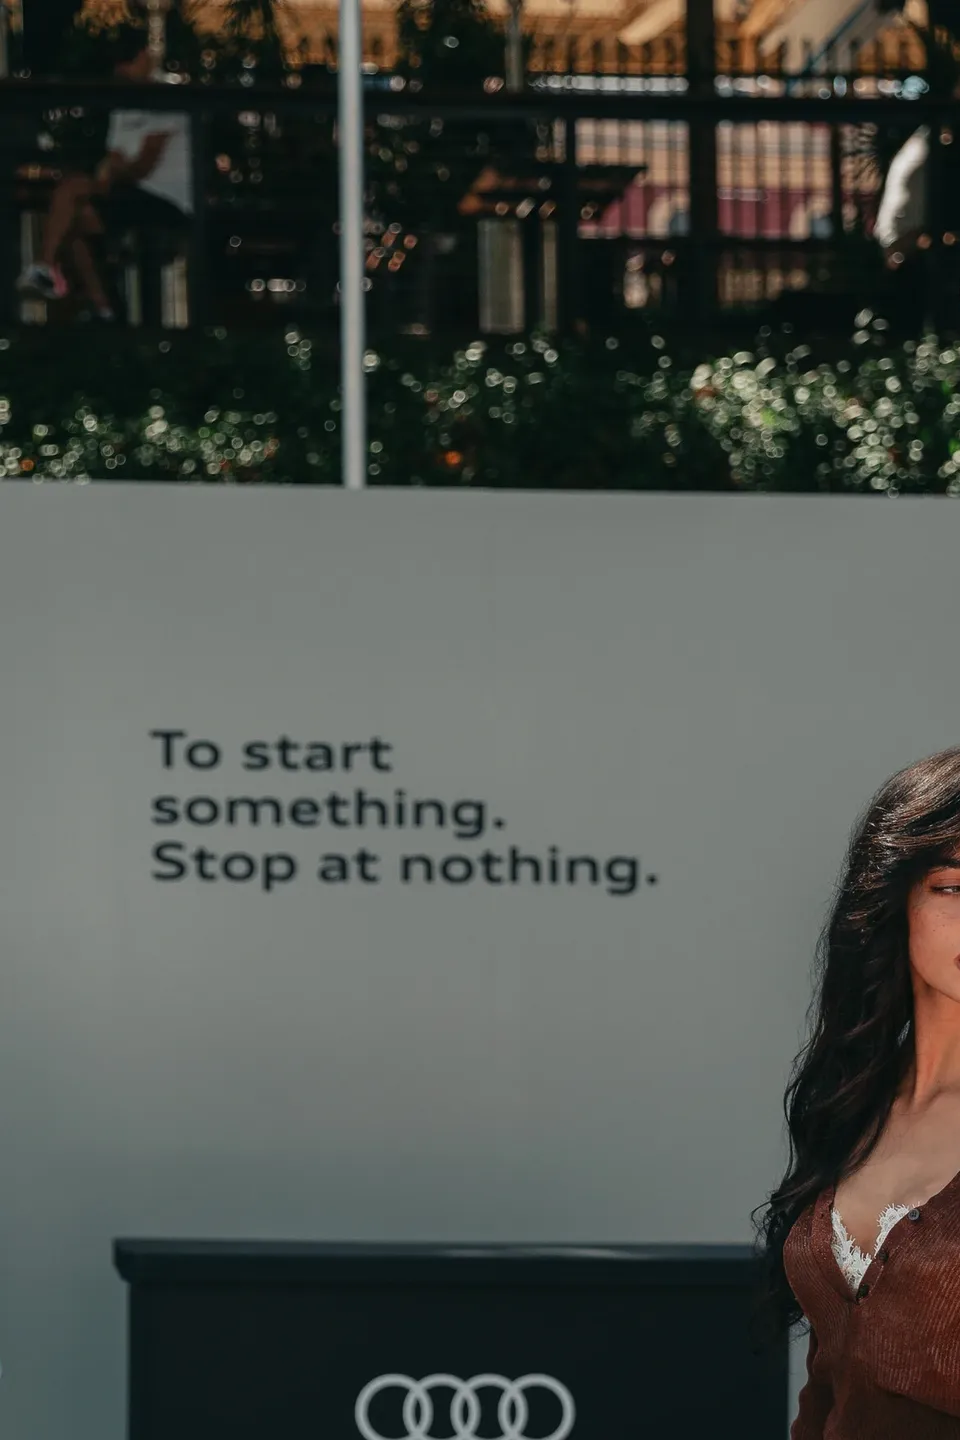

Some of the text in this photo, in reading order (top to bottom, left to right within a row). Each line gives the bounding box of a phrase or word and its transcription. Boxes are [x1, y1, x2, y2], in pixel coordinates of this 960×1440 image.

[150, 730, 392, 773] To start
[151, 790, 505, 839] something.
[151, 842, 659, 896] Stop at nothing.
